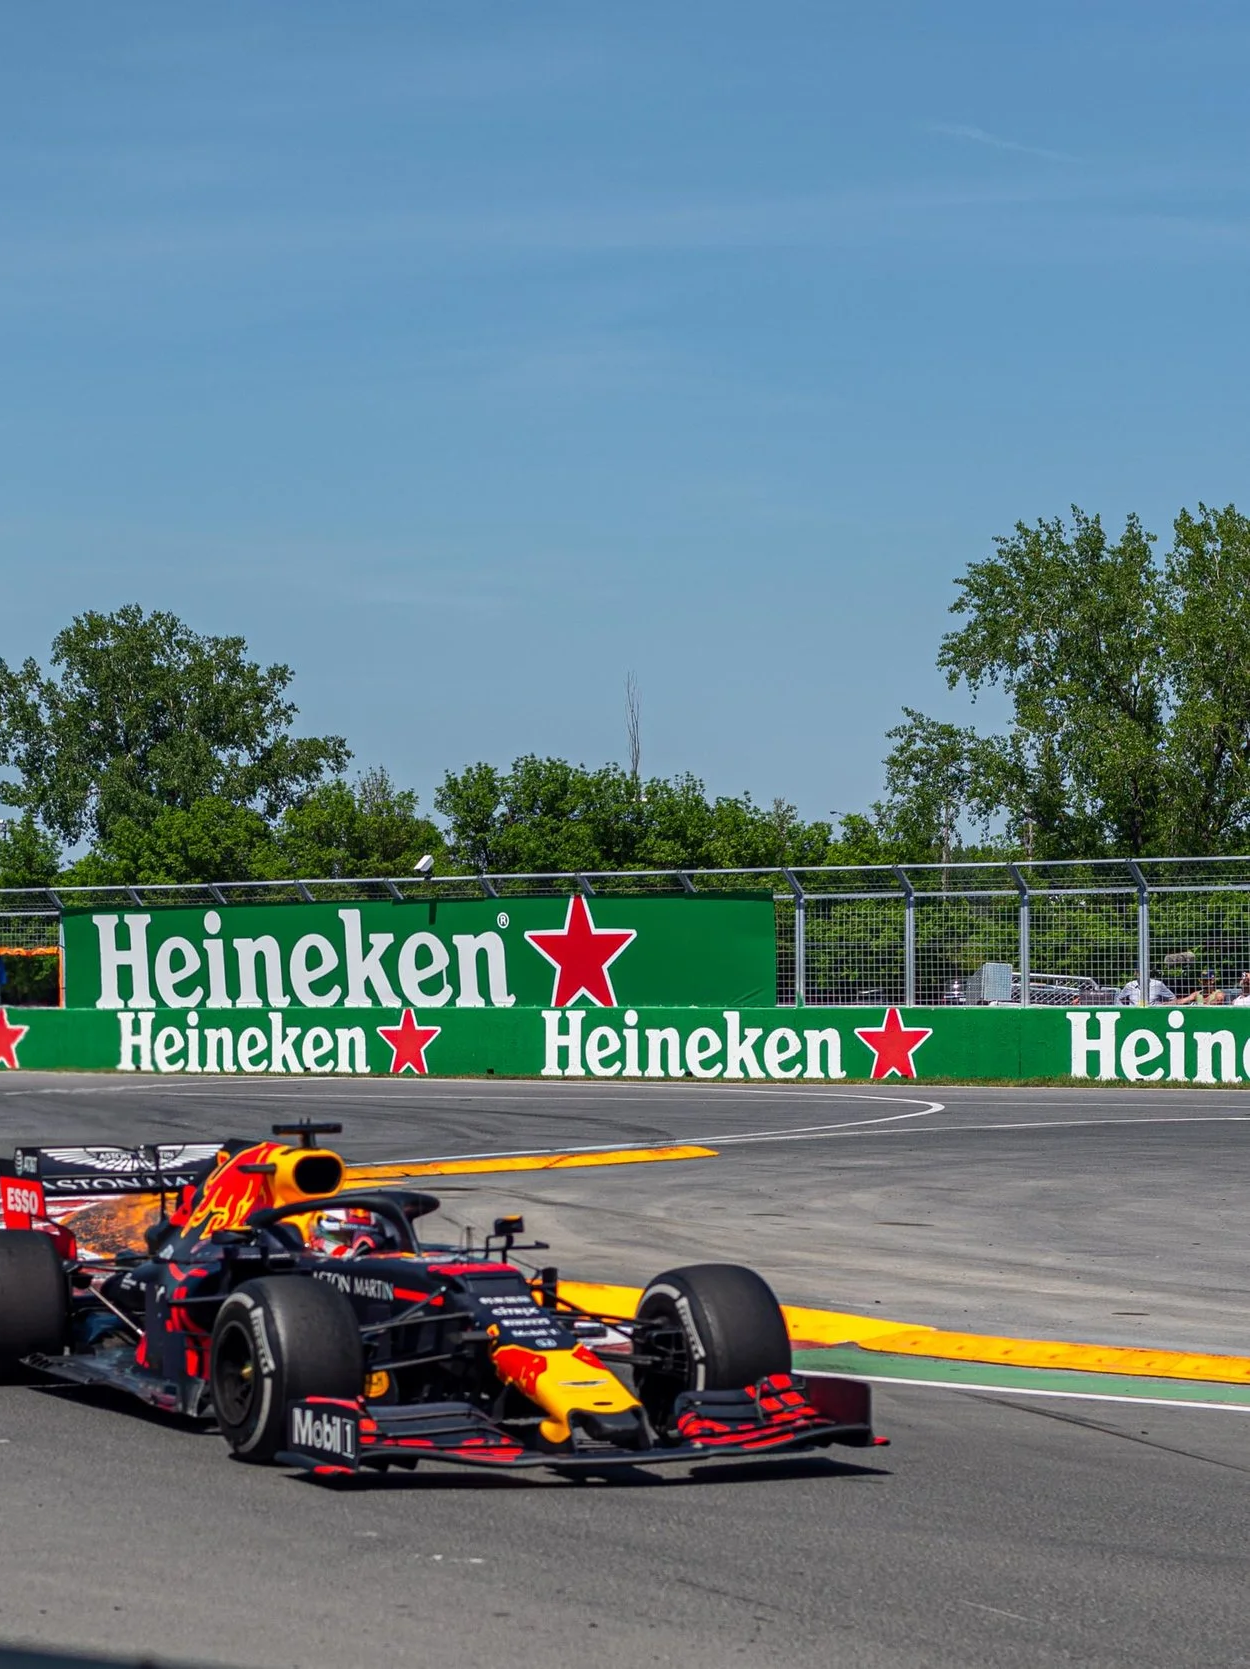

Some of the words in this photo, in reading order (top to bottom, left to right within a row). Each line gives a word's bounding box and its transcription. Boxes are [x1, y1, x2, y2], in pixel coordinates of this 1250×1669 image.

[116, 1011, 371, 1073] Heineken
[541, 1009, 847, 1079] Heineken
[1066, 1010, 1250, 1083] Hein
[7, 1187, 39, 1215] ESSO
[353, 1276, 395, 1301] MARTIN
[292, 1407, 341, 1454] Mobil
[344, 1421, 354, 1457] 1
